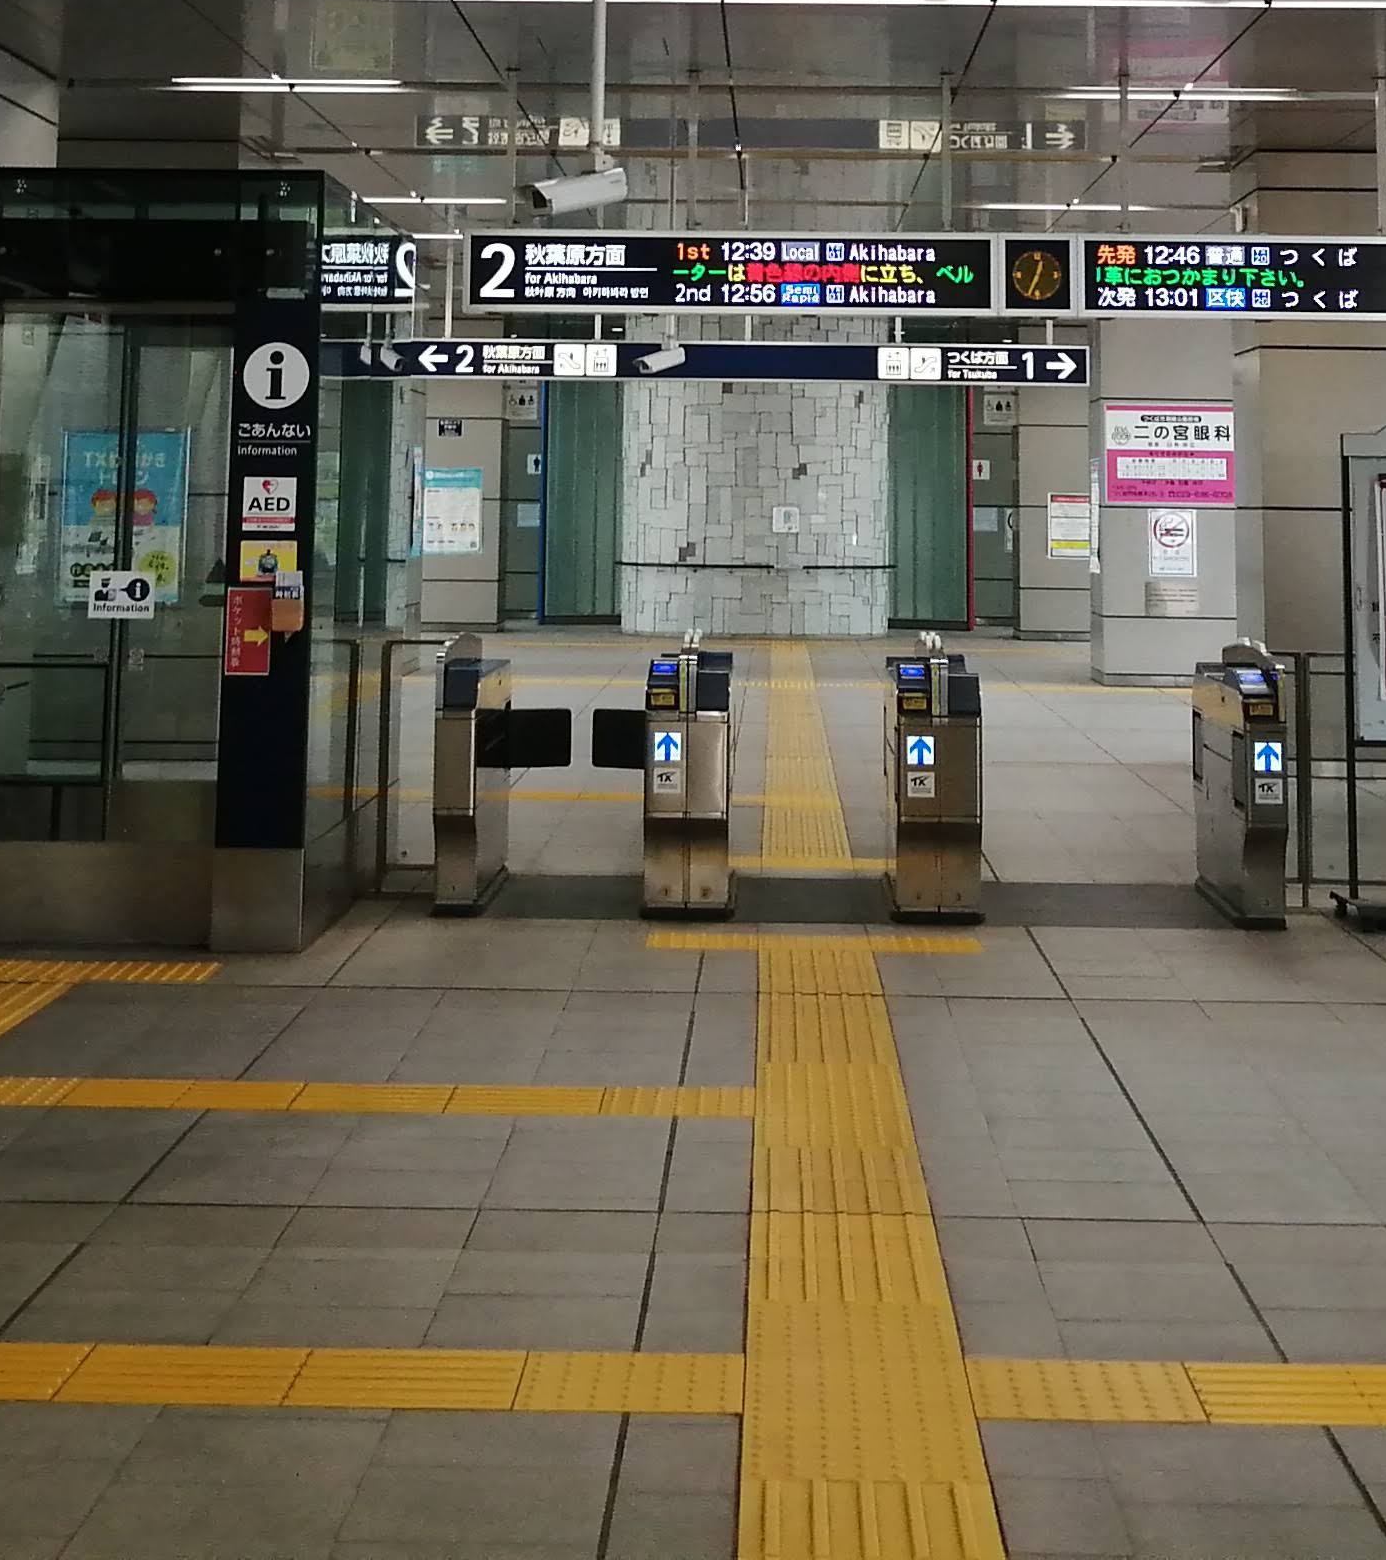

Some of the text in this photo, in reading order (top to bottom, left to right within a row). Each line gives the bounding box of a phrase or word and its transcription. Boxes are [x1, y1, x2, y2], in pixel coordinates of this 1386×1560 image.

[524, 243, 626, 266] 秋葉原方面
[676, 242, 935, 262] 1st 12:39 Local Akihabara
[1097, 244, 1136, 265] 先発
[1144, 245, 1201, 265] 12:46
[480, 243, 515, 297] 2
[525, 272, 598, 285] for Akihabara
[1095, 267, 1305, 288] 革におつかまり下さい。
[675, 285, 776, 304] 2nd 12:56
[849, 286, 935, 304] Akihabara
[1097, 287, 1136, 307] 次発
[1144, 288, 1198, 307] 13:01
[455, 344, 474, 373] 2
[482, 345, 546, 360] 秋葉原方面
[947, 350, 1009, 366] つくば方面
[1021, 351, 1034, 380] 1
[237, 423, 311, 438] ごあんない
[1133, 425, 1231, 442] 二の宮眼科
[237, 445, 297, 457] Information
[248, 496, 290, 513] AED
[93, 603, 150, 613] Information
